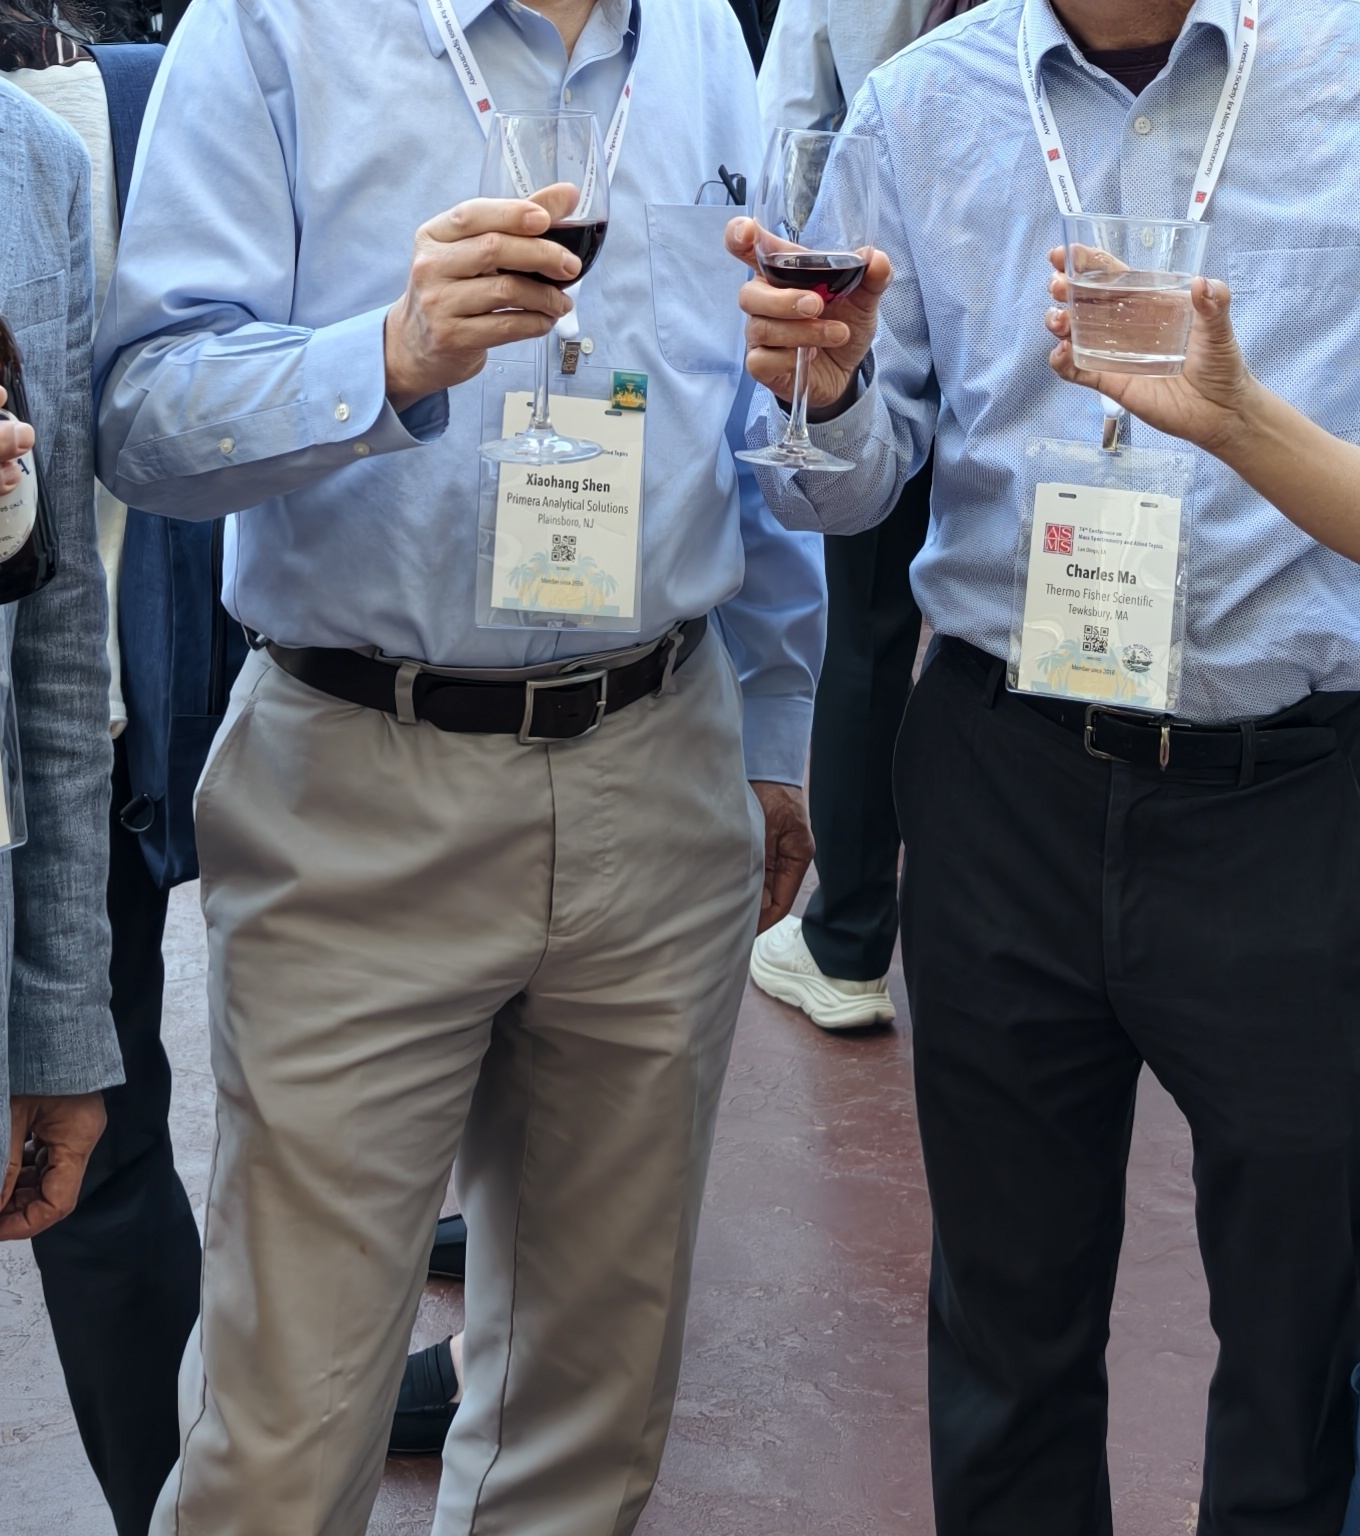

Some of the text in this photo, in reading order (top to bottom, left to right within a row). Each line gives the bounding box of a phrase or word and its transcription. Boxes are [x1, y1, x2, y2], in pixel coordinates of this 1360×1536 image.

[445, 20, 456, 39] Mass
[452, 39, 477, 86] Spectrometry
[1204, 42, 1249, 177] American Society for Mass Spectrometry
[526, 473, 610, 493] Xiaohang Shen
[506, 492, 629, 515] Primera Analytical Solutions
[537, 513, 595, 529] Plainsboro, NJ
[1088, 528, 1115, 536] Conference
[1090, 536, 1123, 545] Spectrometry
[1066, 563, 1137, 585] Charles Ma
[1046, 583, 1154, 608] Thermo Fisher Scientific
[1068, 604, 1129, 622] Tewksbury, MA
